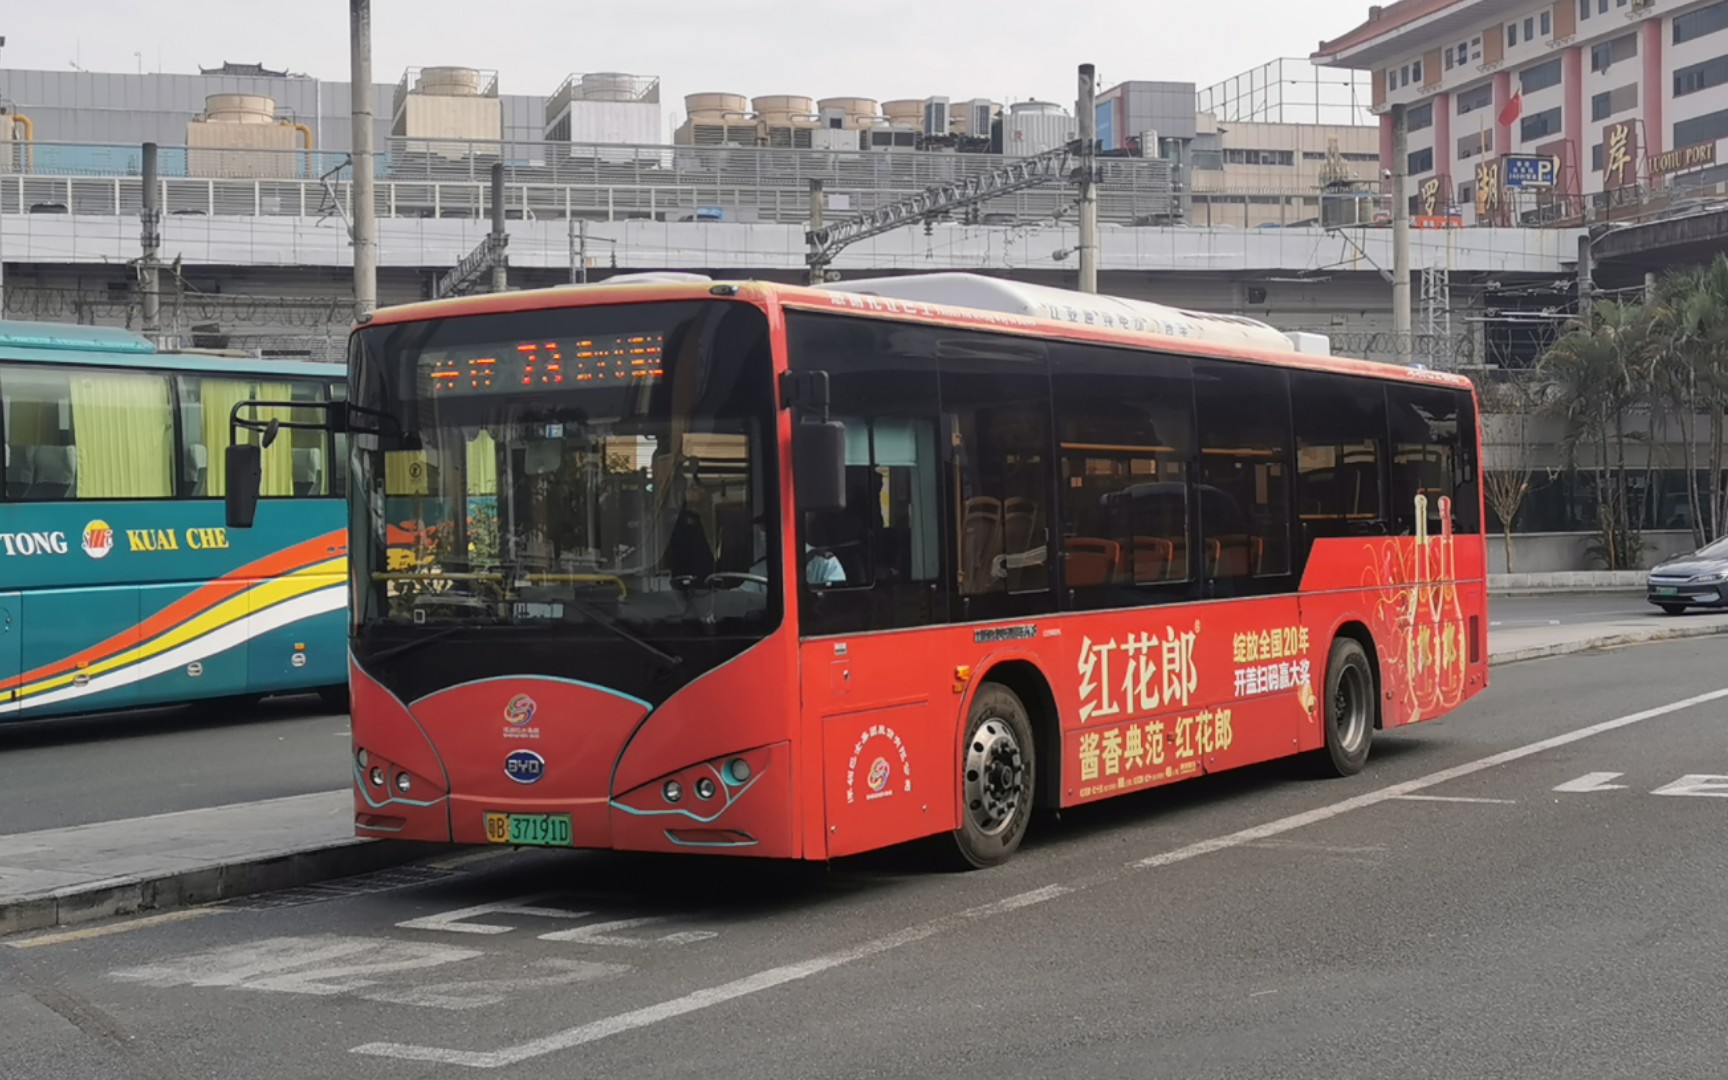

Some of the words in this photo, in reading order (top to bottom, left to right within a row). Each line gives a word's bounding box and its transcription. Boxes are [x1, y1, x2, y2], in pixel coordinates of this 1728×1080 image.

[1686, 143, 1713, 164] PORT
[1538, 160, 1551, 181] P
[0, 531, 69, 556] TONG
[126, 528, 179, 551] KUAI
[185, 527, 230, 549] CHE
[1232, 625, 1310, 663] 绽放全国20年
[1077, 625, 1199, 724] 红花郎
[1233, 660, 1311, 697] 开盖扫码赢大奖
[507, 759, 540, 773] BYD
